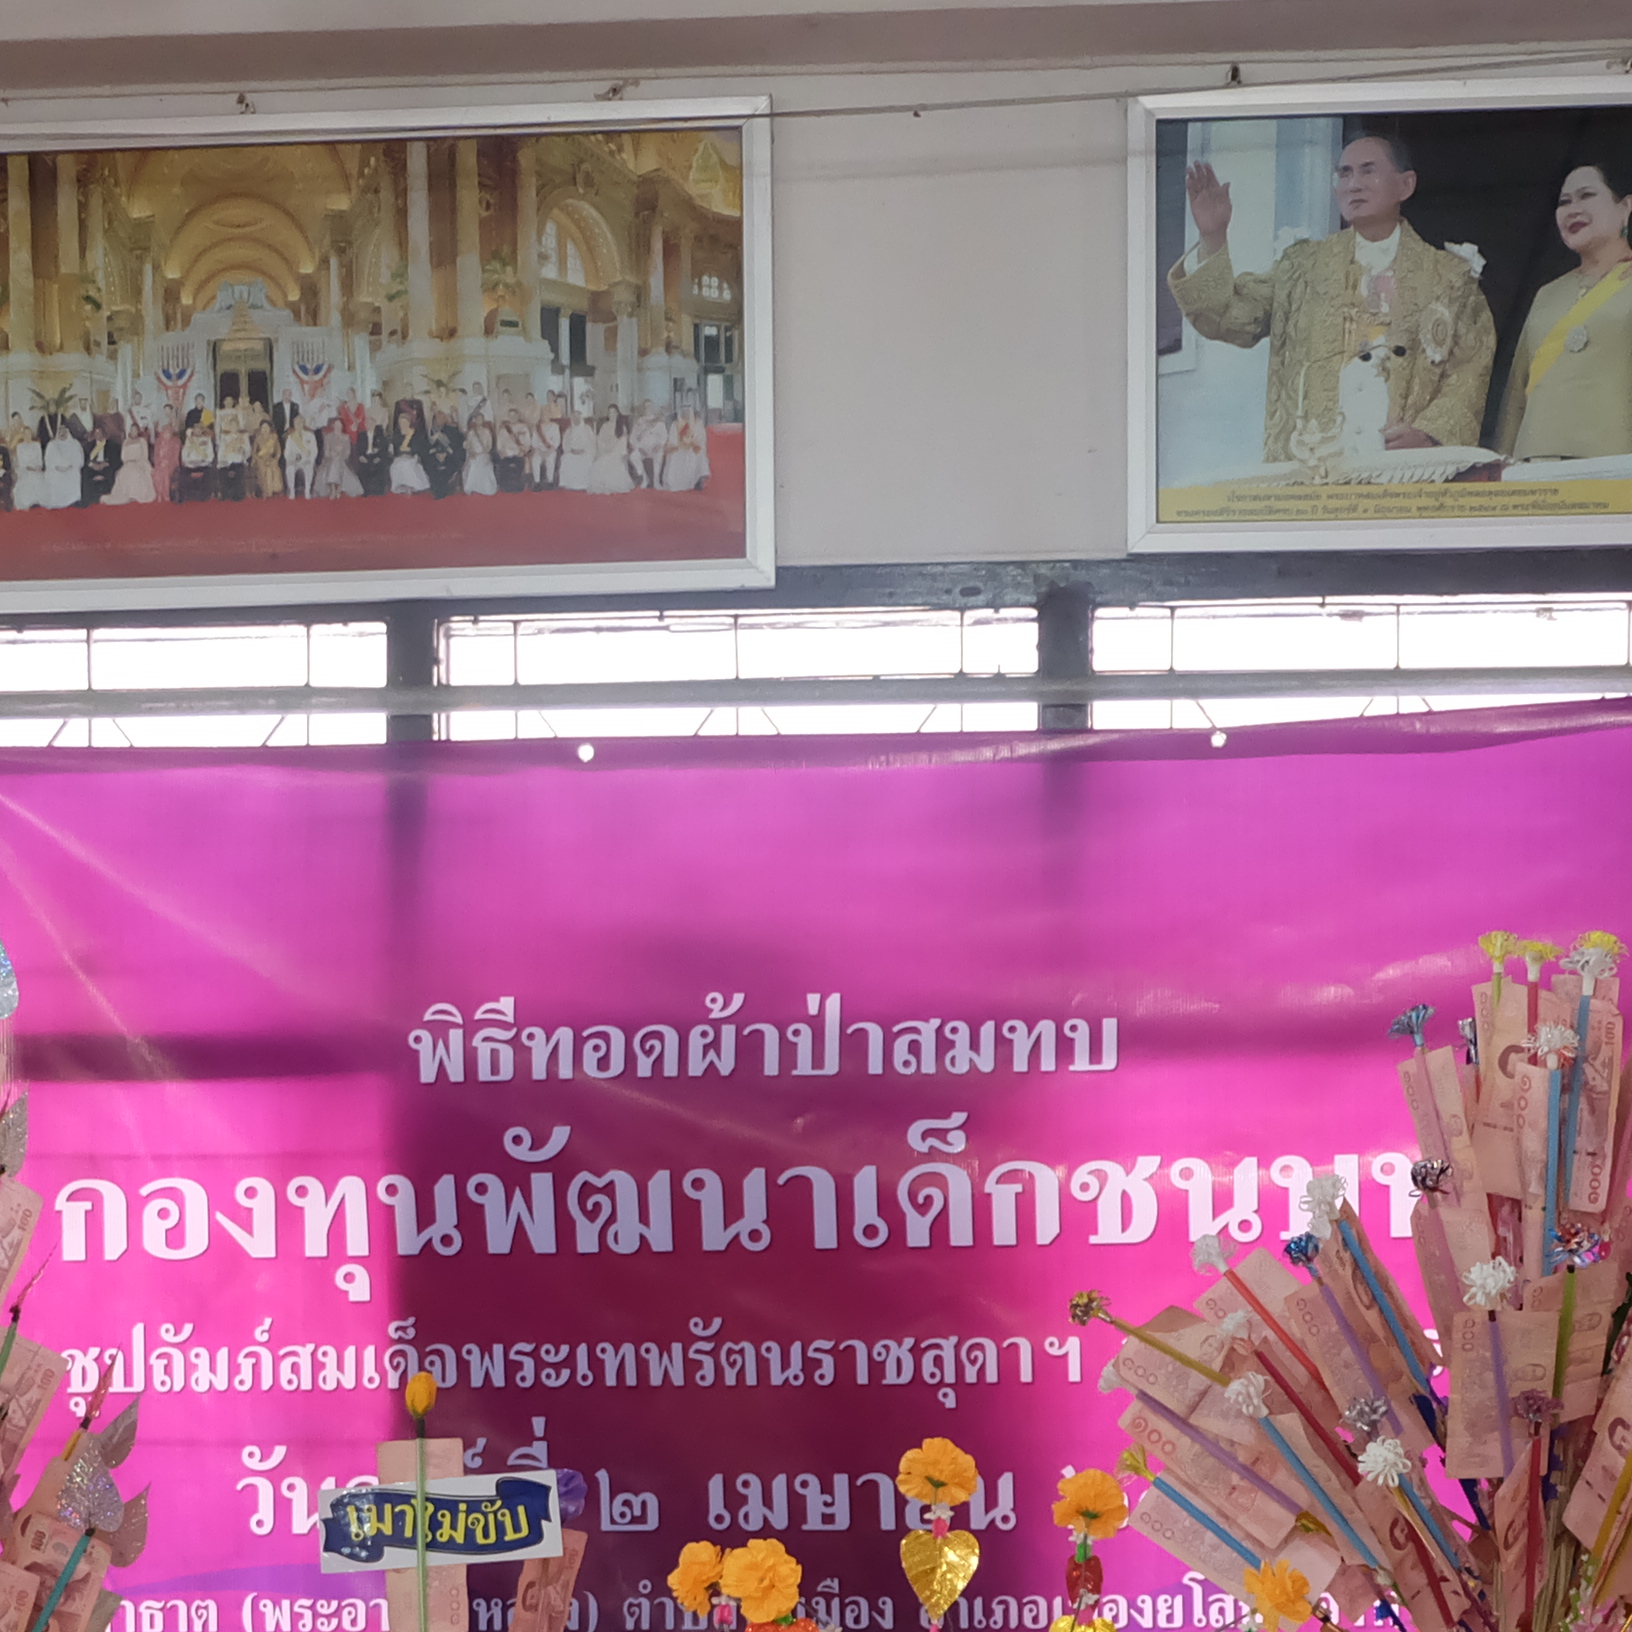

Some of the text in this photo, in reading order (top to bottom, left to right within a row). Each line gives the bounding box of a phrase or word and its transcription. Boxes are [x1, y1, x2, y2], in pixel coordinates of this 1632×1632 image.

[407, 993, 1123, 1085] พิธีทอดผ้าป่าสมทบ
[60, 1316, 1084, 1418] ชูปถัมภ์สมเด็จพระเทพรัตนราชสุดาฯ
[346, 1498, 530, 1545] เมาไม่ขับ
[594, 1468, 660, 1533] ๒
[706, 1470, 1017, 1533] เมษาน
